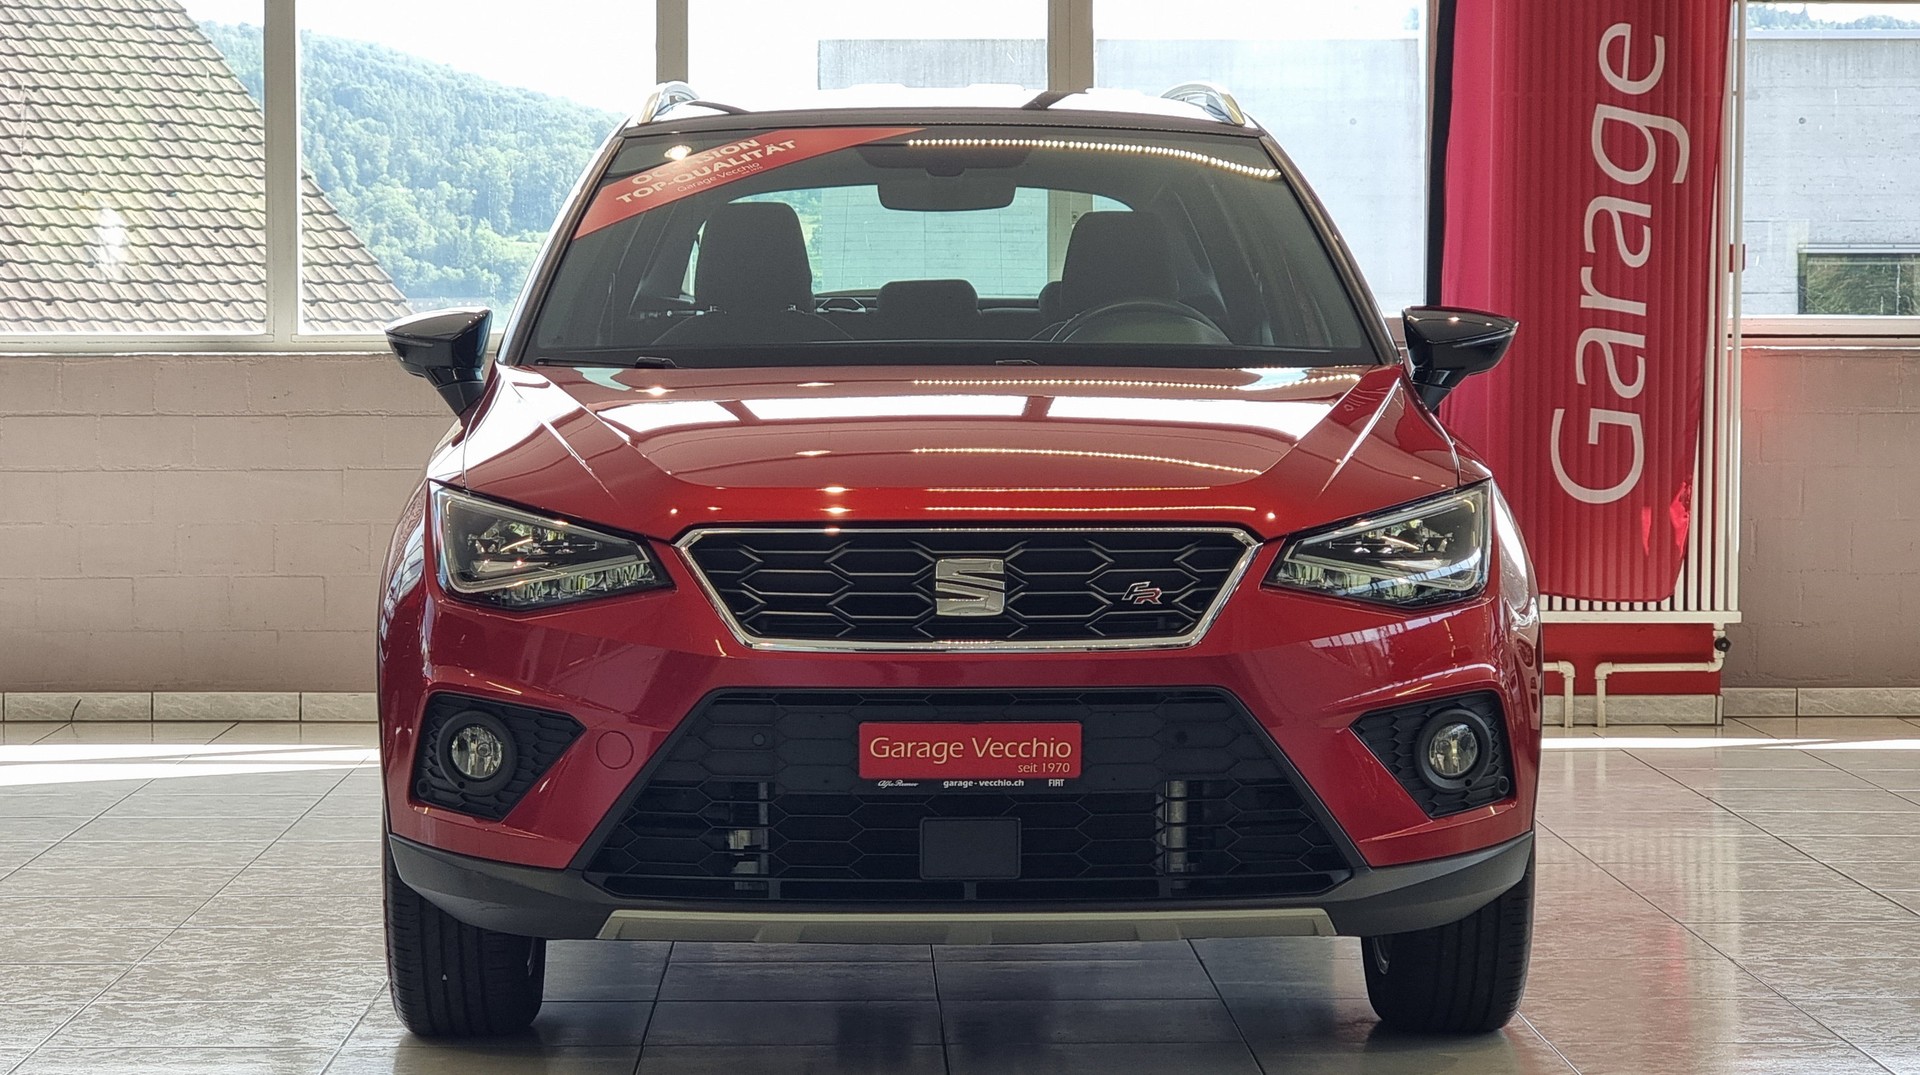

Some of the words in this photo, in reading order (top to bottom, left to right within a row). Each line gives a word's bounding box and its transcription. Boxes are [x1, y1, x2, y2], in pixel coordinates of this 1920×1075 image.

[616, 140, 796, 203] TOP-QUALITÄT
[631, 139, 761, 185] OCSION
[677, 175, 717, 192] Garage
[716, 162, 760, 178] Vecchio
[1549, 22, 1691, 505] Garage
[869, 737, 964, 765] Garage
[971, 737, 1072, 758] Vecchio
[1017, 762, 1038, 773] seit
[1042, 762, 1071, 774] 1970
[1048, 779, 1065, 787] FIAT
